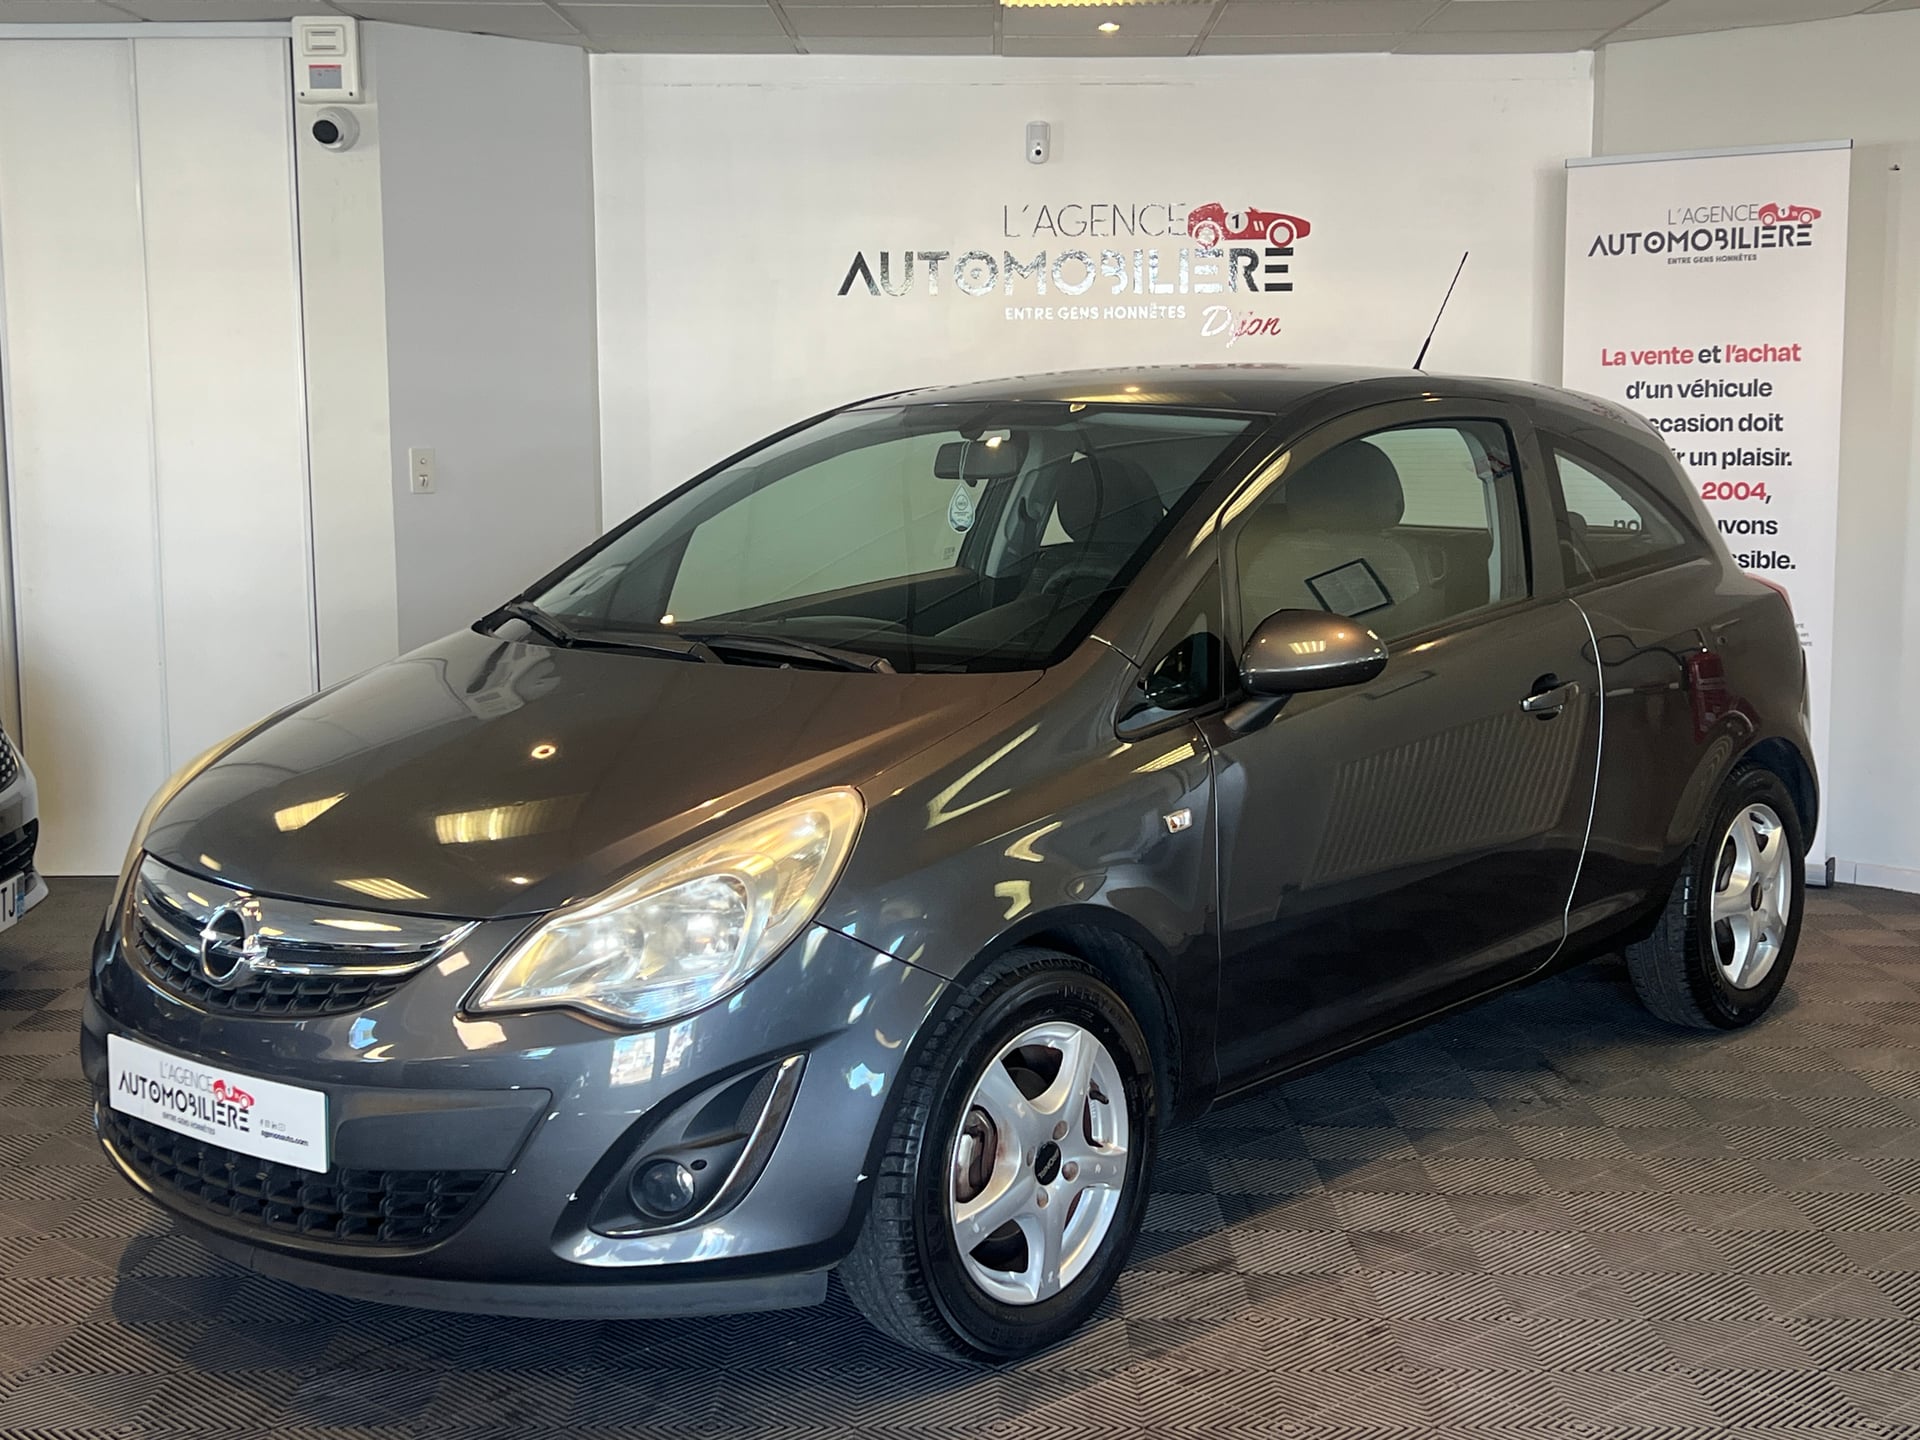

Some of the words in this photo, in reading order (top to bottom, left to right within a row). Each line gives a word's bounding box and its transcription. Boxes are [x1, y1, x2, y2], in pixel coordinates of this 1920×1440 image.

[1003, 203, 1188, 238] L'AGENCE
[1231, 213, 1240, 230] 1
[1667, 203, 1759, 225] L'AGENCE
[1004, 306, 1054, 321] ENTRE
[1057, 306, 1100, 320] GENS
[1103, 302, 1187, 320] HONNÊTES
[1601, 348, 1627, 367] La
[1630, 346, 1694, 366] vente
[1698, 345, 1722, 364] et
[1725, 343, 1801, 363] l'achat
[1625, 380, 1673, 400] d'un
[1677, 378, 1773, 399] véhicule
[1738, 413, 1784, 432] doit
[1689, 451, 1717, 466] un
[1721, 447, 1793, 470] plaisir.
[1701, 481, 1772, 504] 2004,
[1613, 519, 1640, 531] no
[1732, 550, 1796, 570] sible.
[159, 1060, 214, 1094] L'AGENCE
